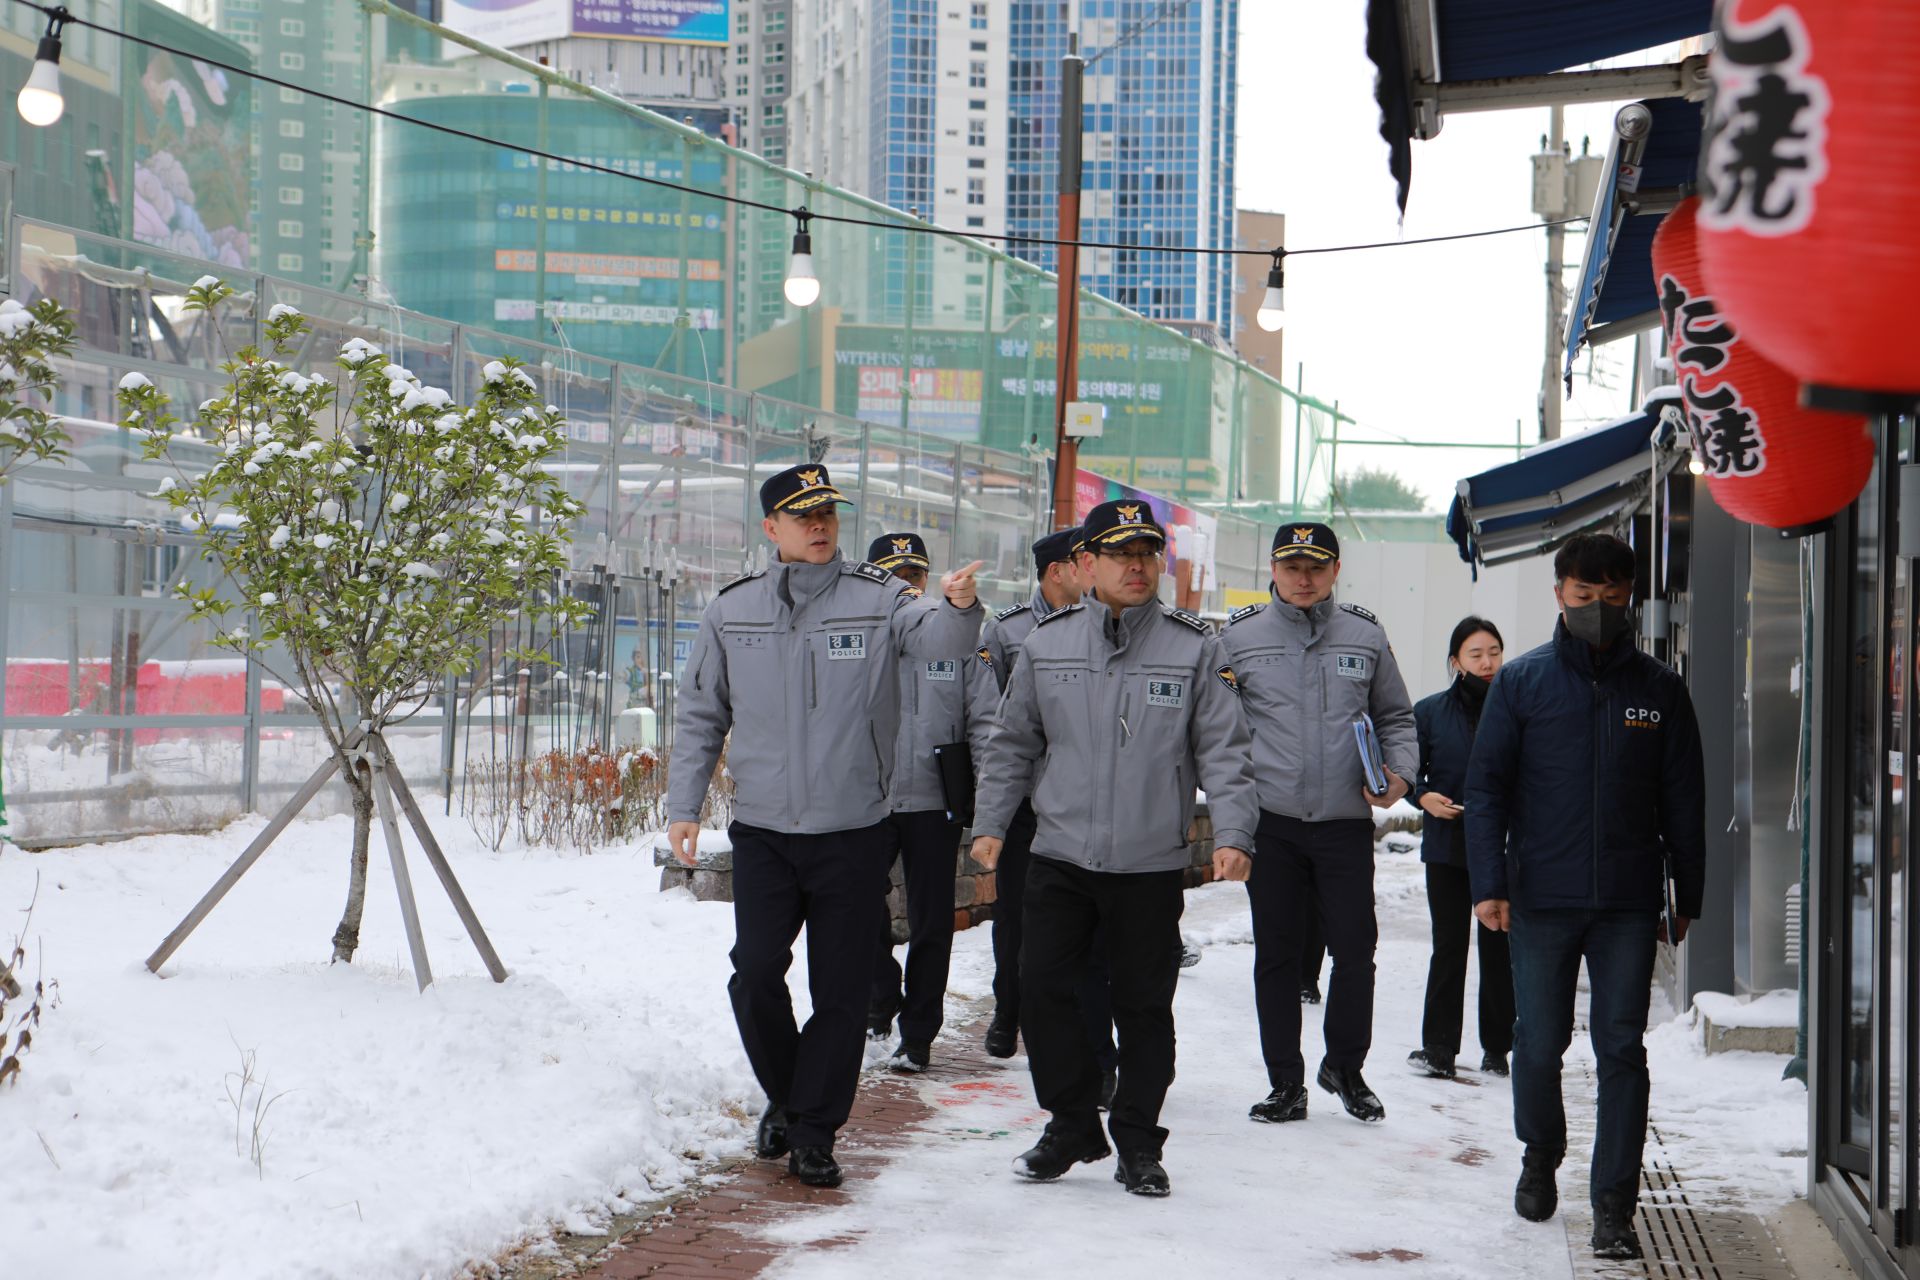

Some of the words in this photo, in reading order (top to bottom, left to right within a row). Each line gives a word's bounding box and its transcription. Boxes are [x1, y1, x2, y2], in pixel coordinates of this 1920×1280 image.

[611, 307, 635, 320] 요가
[836, 351, 874, 366] WITH
[860, 370, 935, 397] 오피텔
[1001, 377, 1162, 401] 백운마취증의학과의원
[831, 649, 862, 657] POLICE
[1340, 668, 1364, 677] POLICE
[1151, 696, 1179, 705] POLICE
[1625, 707, 1661, 723] CPO
